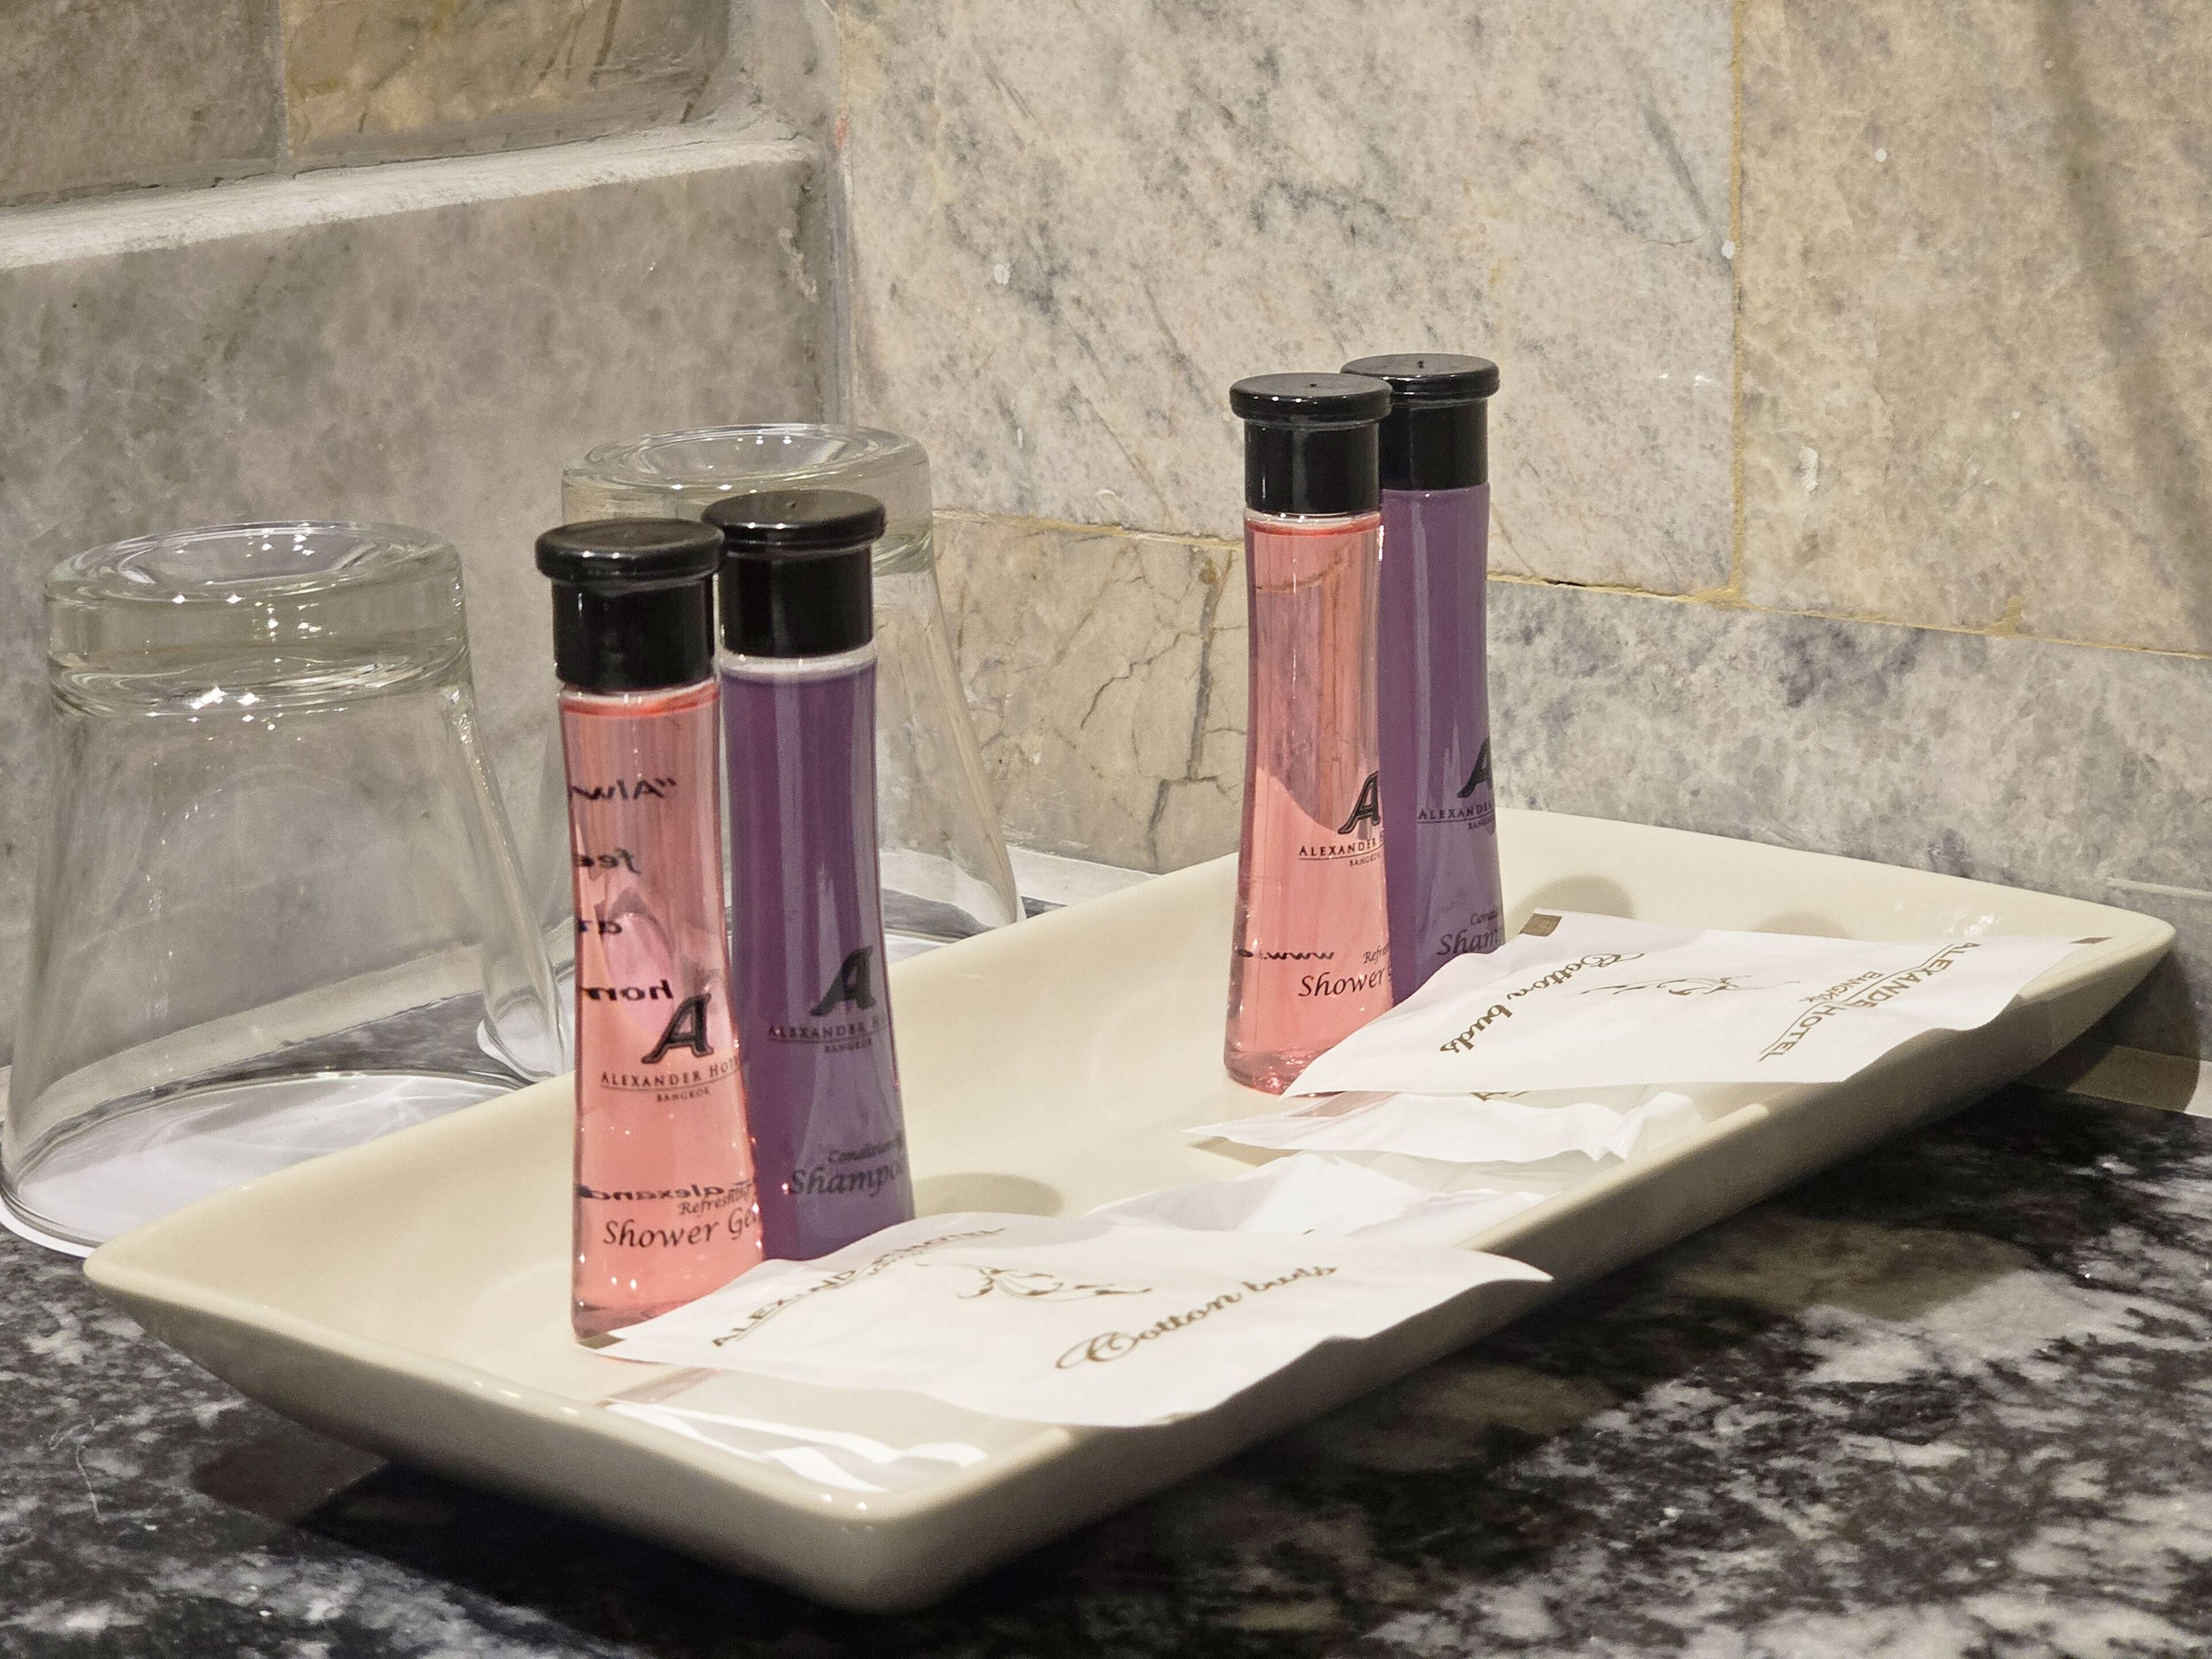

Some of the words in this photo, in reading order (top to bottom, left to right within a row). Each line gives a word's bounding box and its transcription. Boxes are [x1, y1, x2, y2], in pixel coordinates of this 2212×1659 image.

[1337, 770, 1381, 834] A
[1299, 837, 1376, 856] ALEXANDER
[809, 946, 877, 1017] A
[1298, 967, 1385, 997] Shower
[1507, 953, 1645, 1000] Cotton
[1846, 942, 1982, 1008] ALEXANDE
[641, 992, 715, 1064] A
[1440, 1004, 1513, 1053] buds
[1758, 1005, 1847, 1062] HOTEL
[601, 1070, 703, 1088] ALEXANDER
[657, 1085, 710, 1103] BANGKOK
[788, 1160, 902, 1199] Shampo
[603, 1218, 719, 1248] Shower
[1055, 1291, 1242, 1369] Cotton
